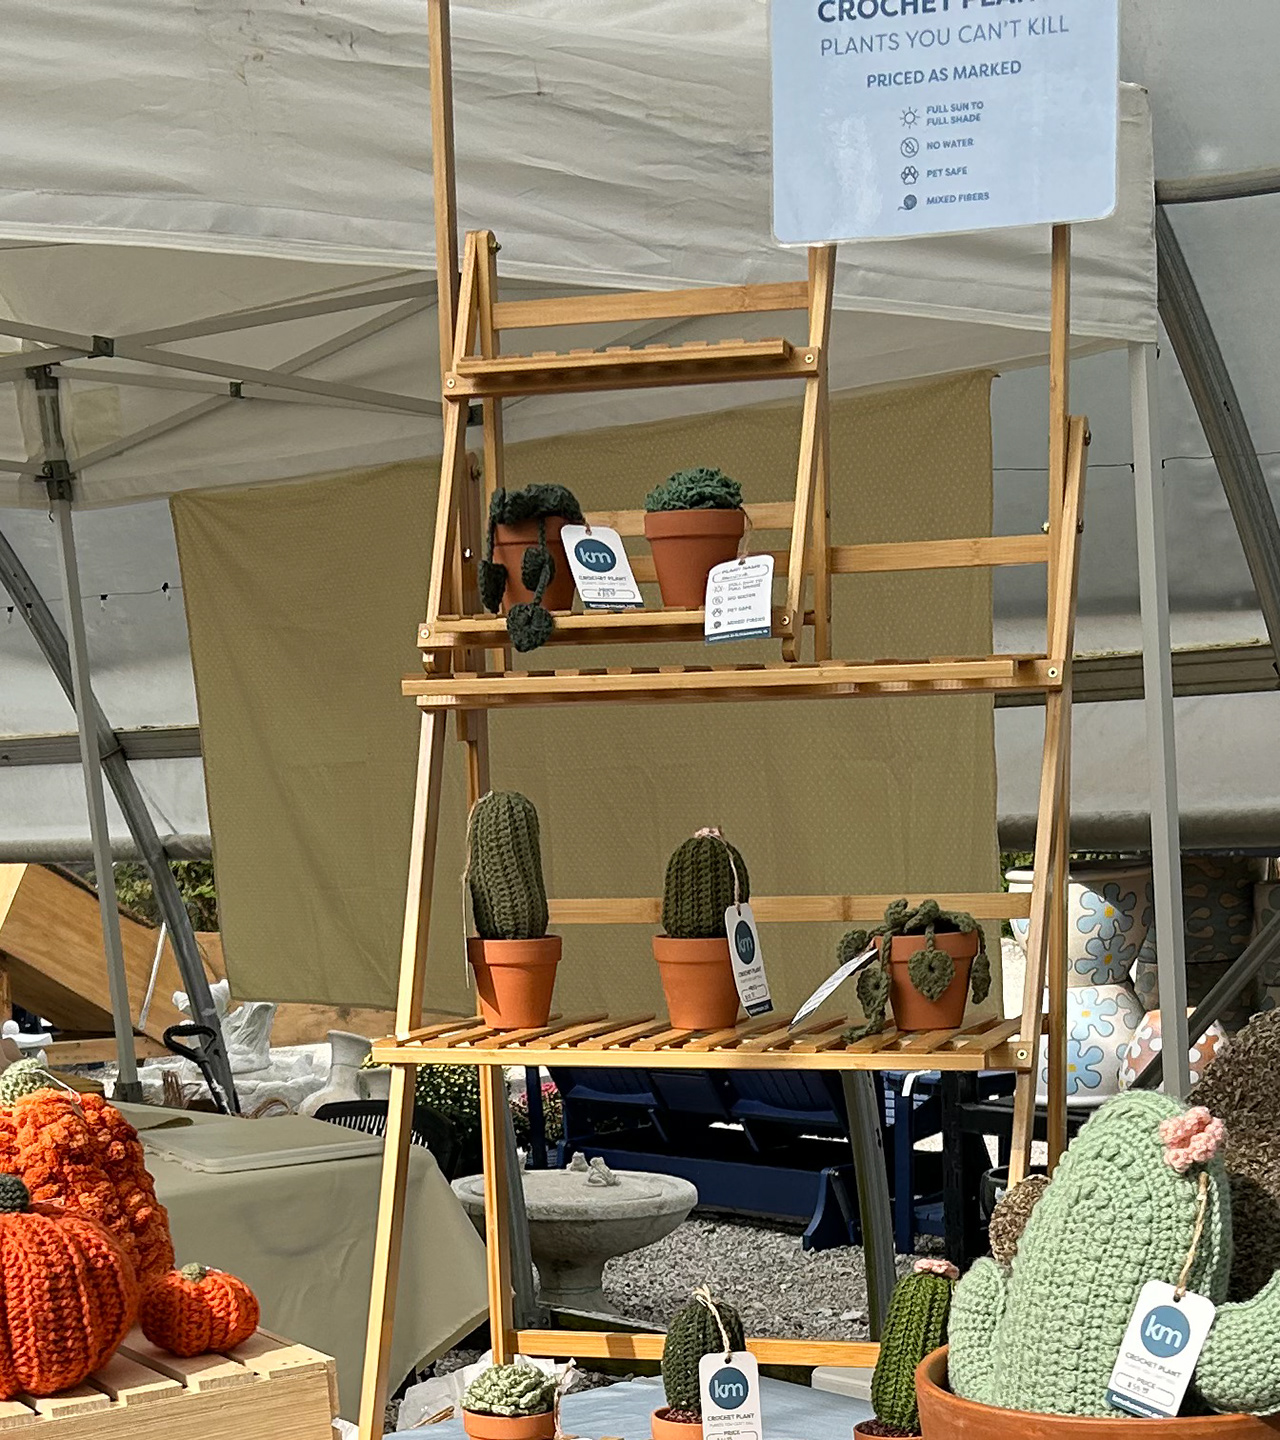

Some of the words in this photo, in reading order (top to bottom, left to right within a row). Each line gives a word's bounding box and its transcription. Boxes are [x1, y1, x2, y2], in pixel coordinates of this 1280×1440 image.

[820, 32, 900, 57] PLANTS
[905, 27, 951, 49] YOU
[957, 19, 1022, 44] CAN'T
[1027, 14, 1070, 37] KILL
[867, 70, 925, 88] PRICED
[928, 67, 949, 83] AS
[952, 59, 1022, 81] MARKED
[926, 104, 949, 115] FULL
[950, 102, 970, 113] SUN
[970, 100, 984, 110] TO
[926, 117, 949, 126] FULL
[950, 113, 982, 125] SHADE
[926, 141, 941, 150] NO
[942, 137, 975, 149] WATER
[926, 168, 944, 178] PET
[945, 166, 968, 177] SAFE
[926, 194, 957, 206] MIXED
[958, 191, 990, 203] FIBERS
[579, 547, 612, 564] km
[736, 933, 754, 954] km
[1144, 1314, 1183, 1349] km
[713, 1379, 744, 1399] km
